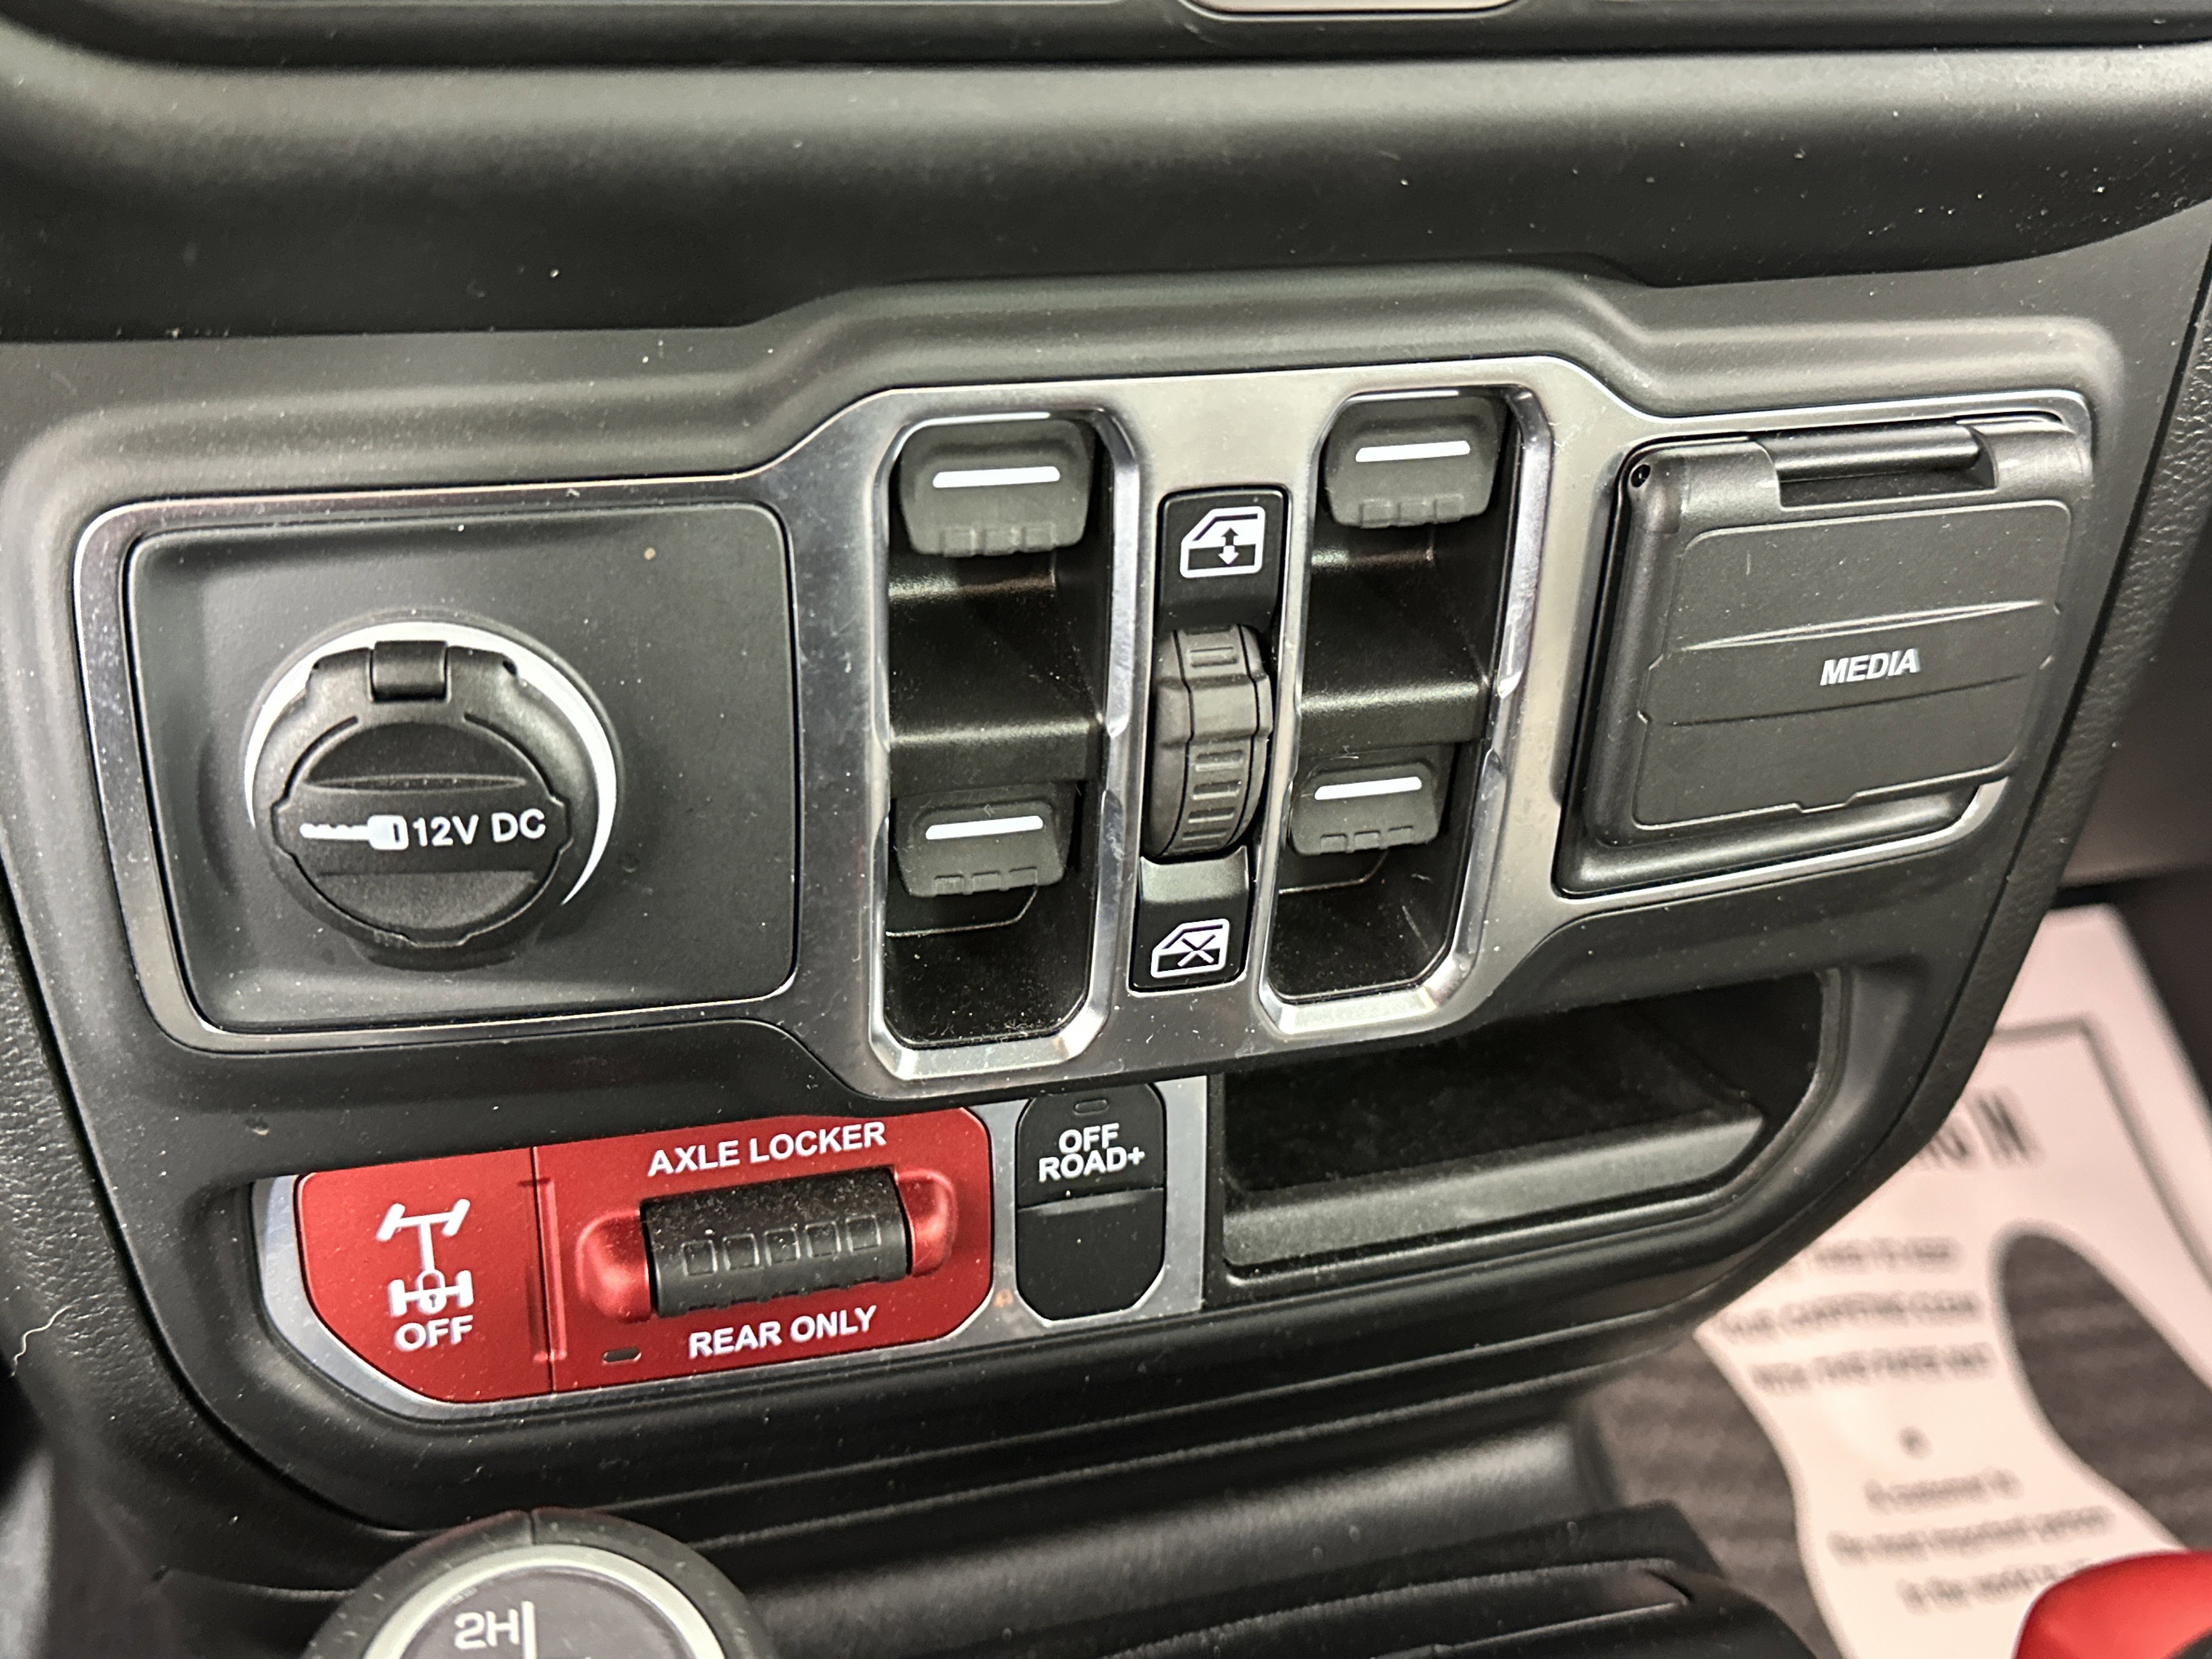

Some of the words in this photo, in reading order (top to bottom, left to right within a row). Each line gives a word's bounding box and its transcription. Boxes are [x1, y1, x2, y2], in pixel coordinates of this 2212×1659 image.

[1820, 648, 1921, 686] MEDIA
[413, 814, 479, 847] 12V
[492, 808, 546, 842] DC
[647, 1140, 740, 1177] AXLE
[749, 1121, 887, 1164] LOCKER
[1058, 1122, 1120, 1154] OFF
[1039, 1146, 1145, 1182] ROAD+
[394, 1315, 473, 1351] OFF
[689, 1320, 783, 1358] REAR
[791, 1305, 877, 1343] ONLY
[454, 1609, 520, 1650] 2H
